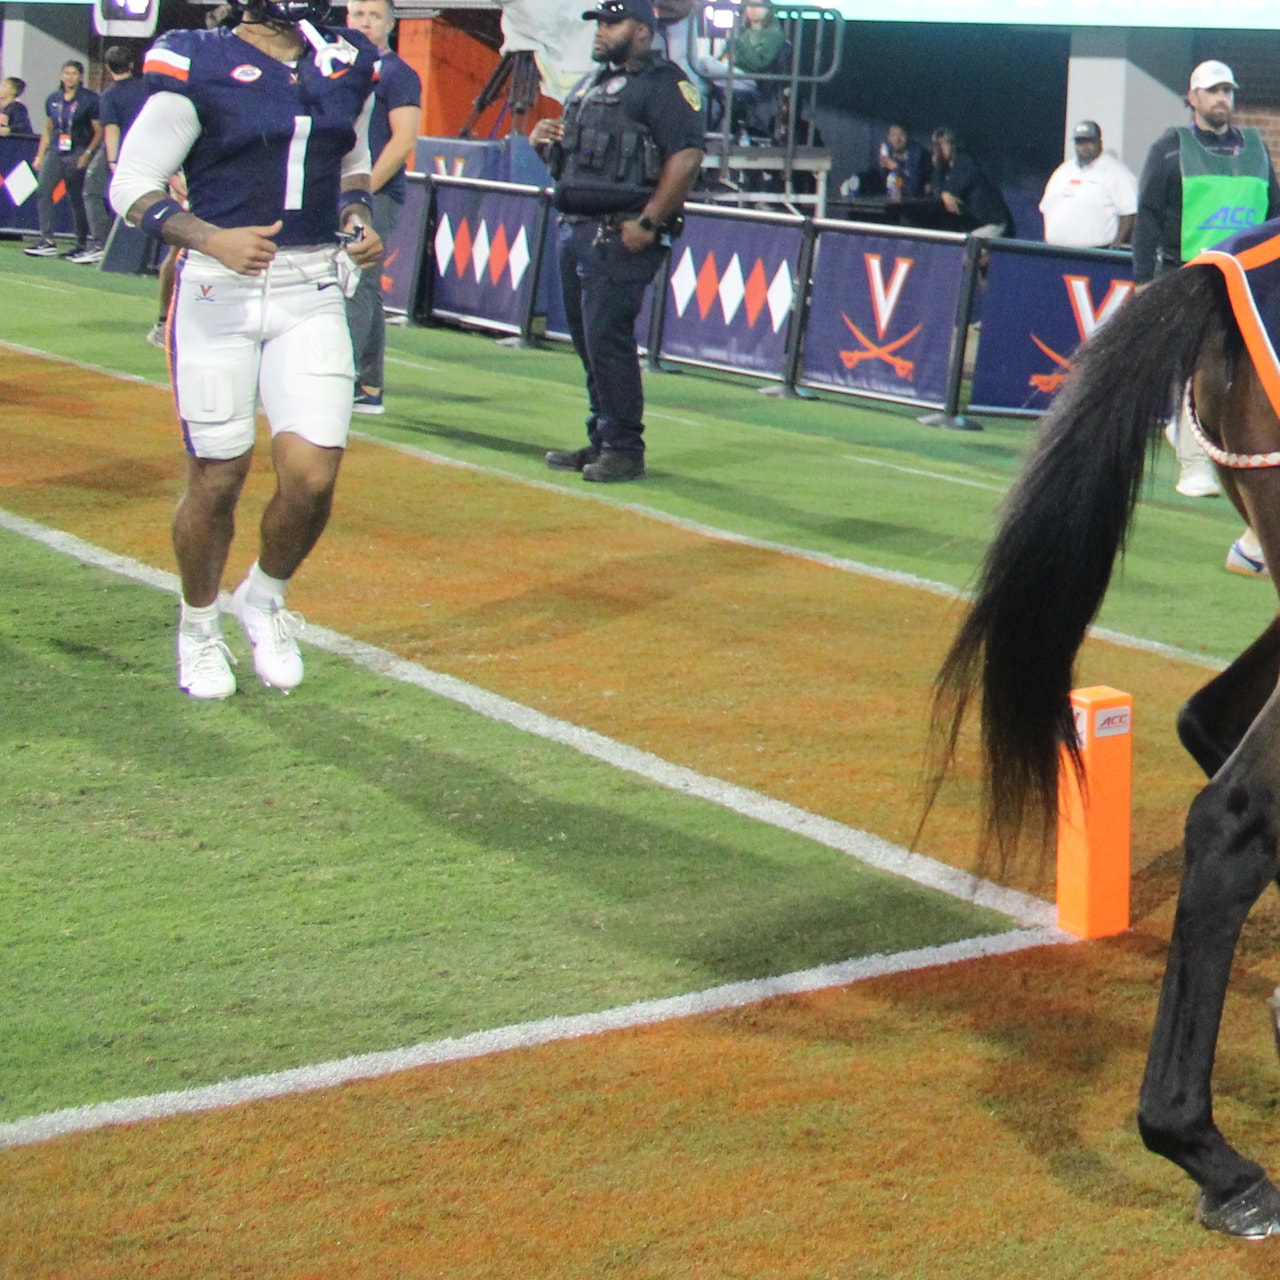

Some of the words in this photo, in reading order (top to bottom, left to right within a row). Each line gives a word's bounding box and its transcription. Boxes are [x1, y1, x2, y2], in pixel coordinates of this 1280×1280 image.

[284, 115, 312, 210] 1
[1204, 205, 1258, 228] ACC
[1099, 713, 1129, 729] ACC
